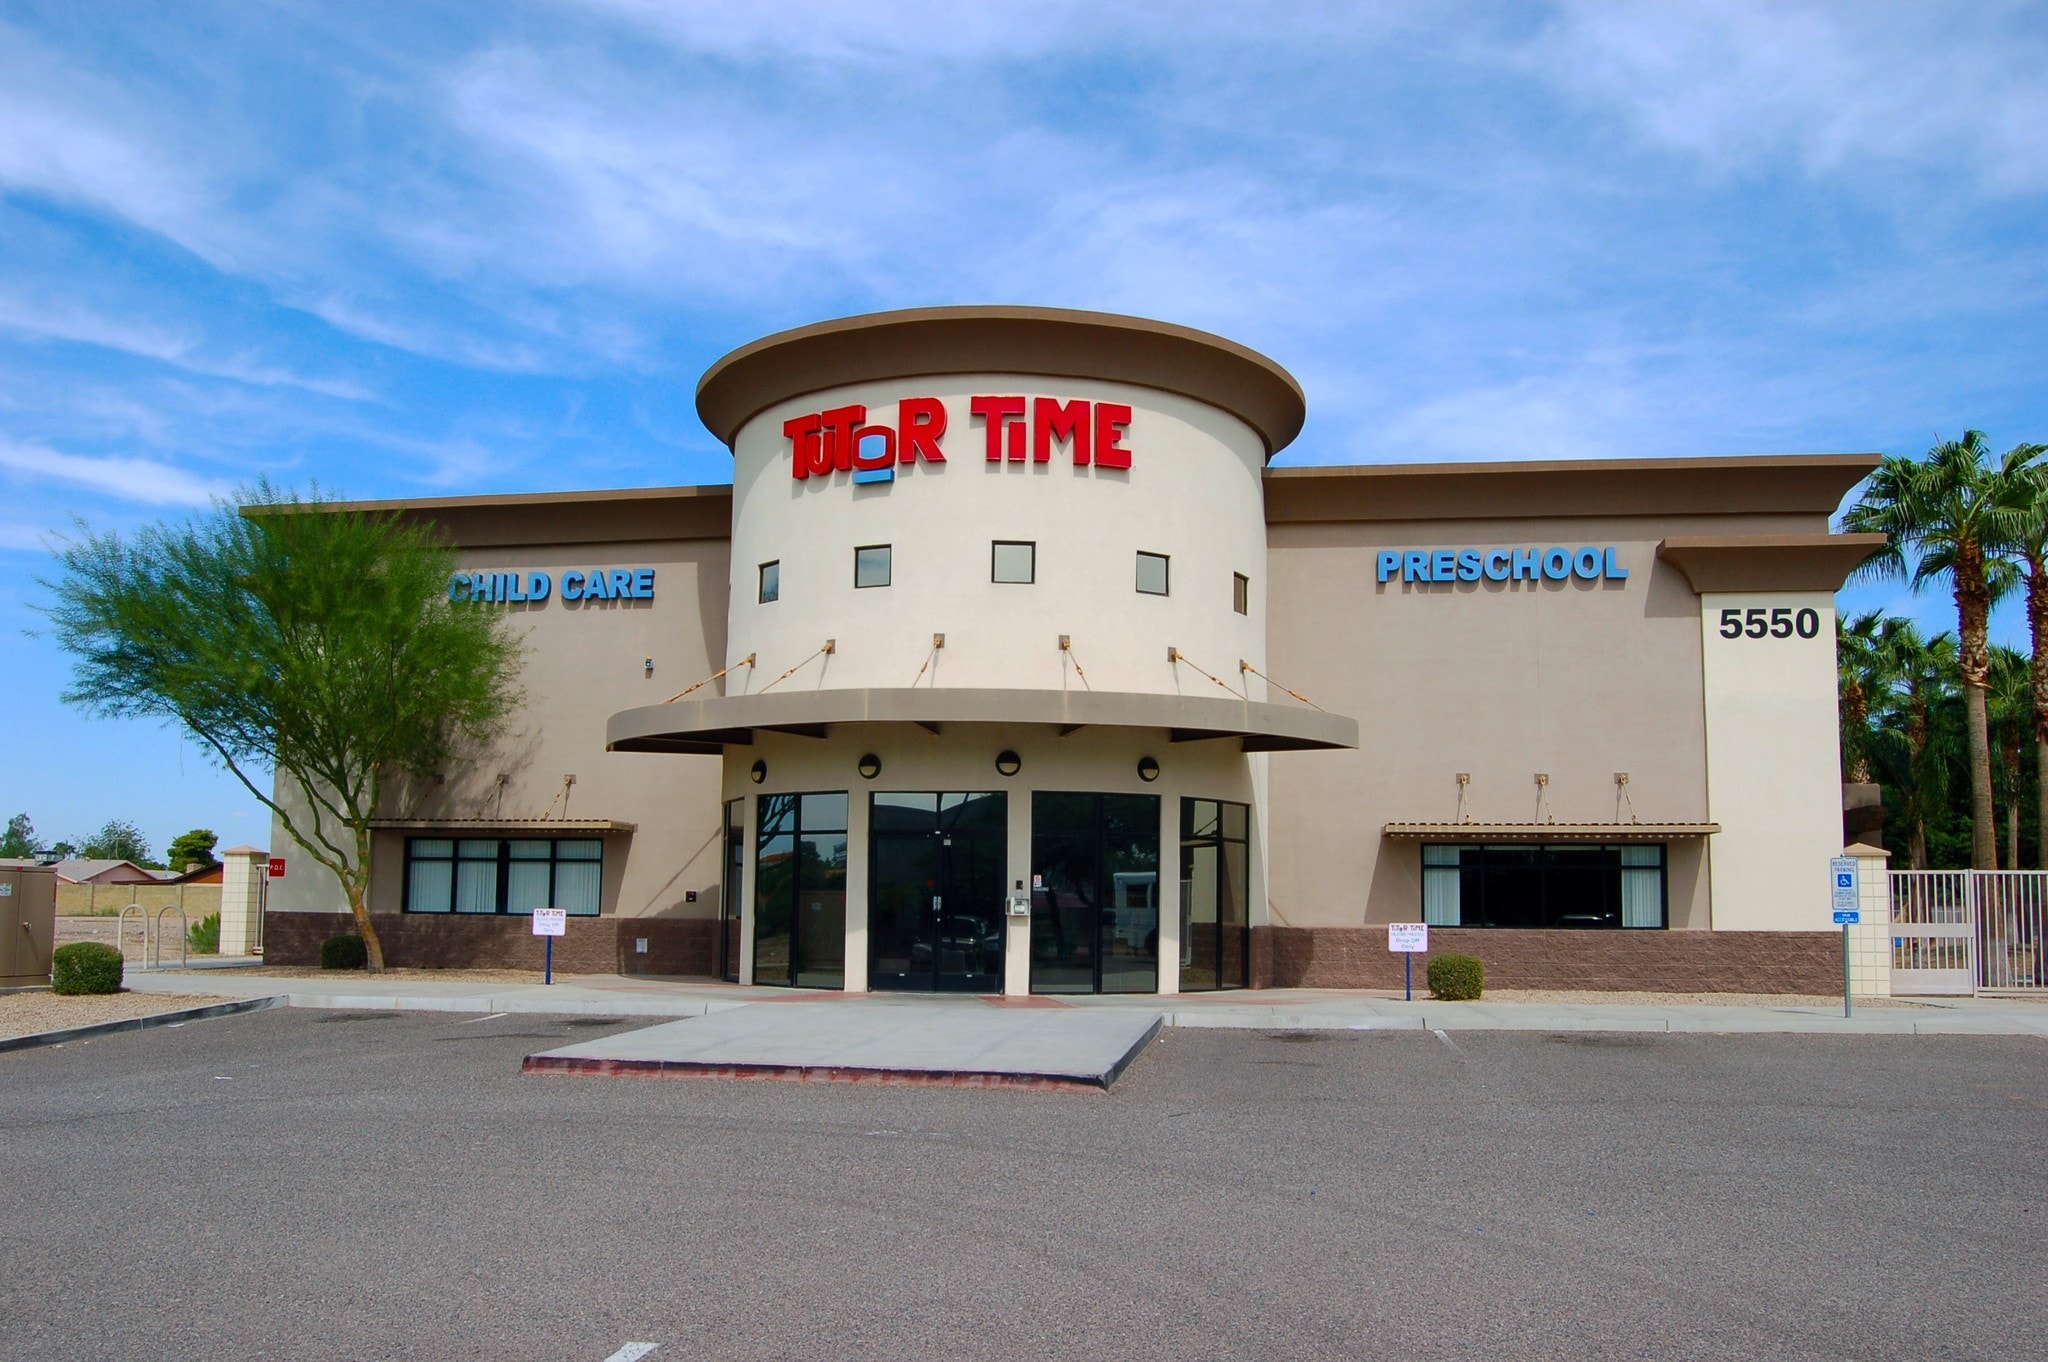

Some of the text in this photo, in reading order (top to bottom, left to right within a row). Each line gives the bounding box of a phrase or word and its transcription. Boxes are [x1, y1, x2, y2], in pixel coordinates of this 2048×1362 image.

[1376, 547, 1629, 582] PRESCHOOL
[448, 568, 655, 603] CHILD CARE
[1720, 608, 1819, 639] 5550
